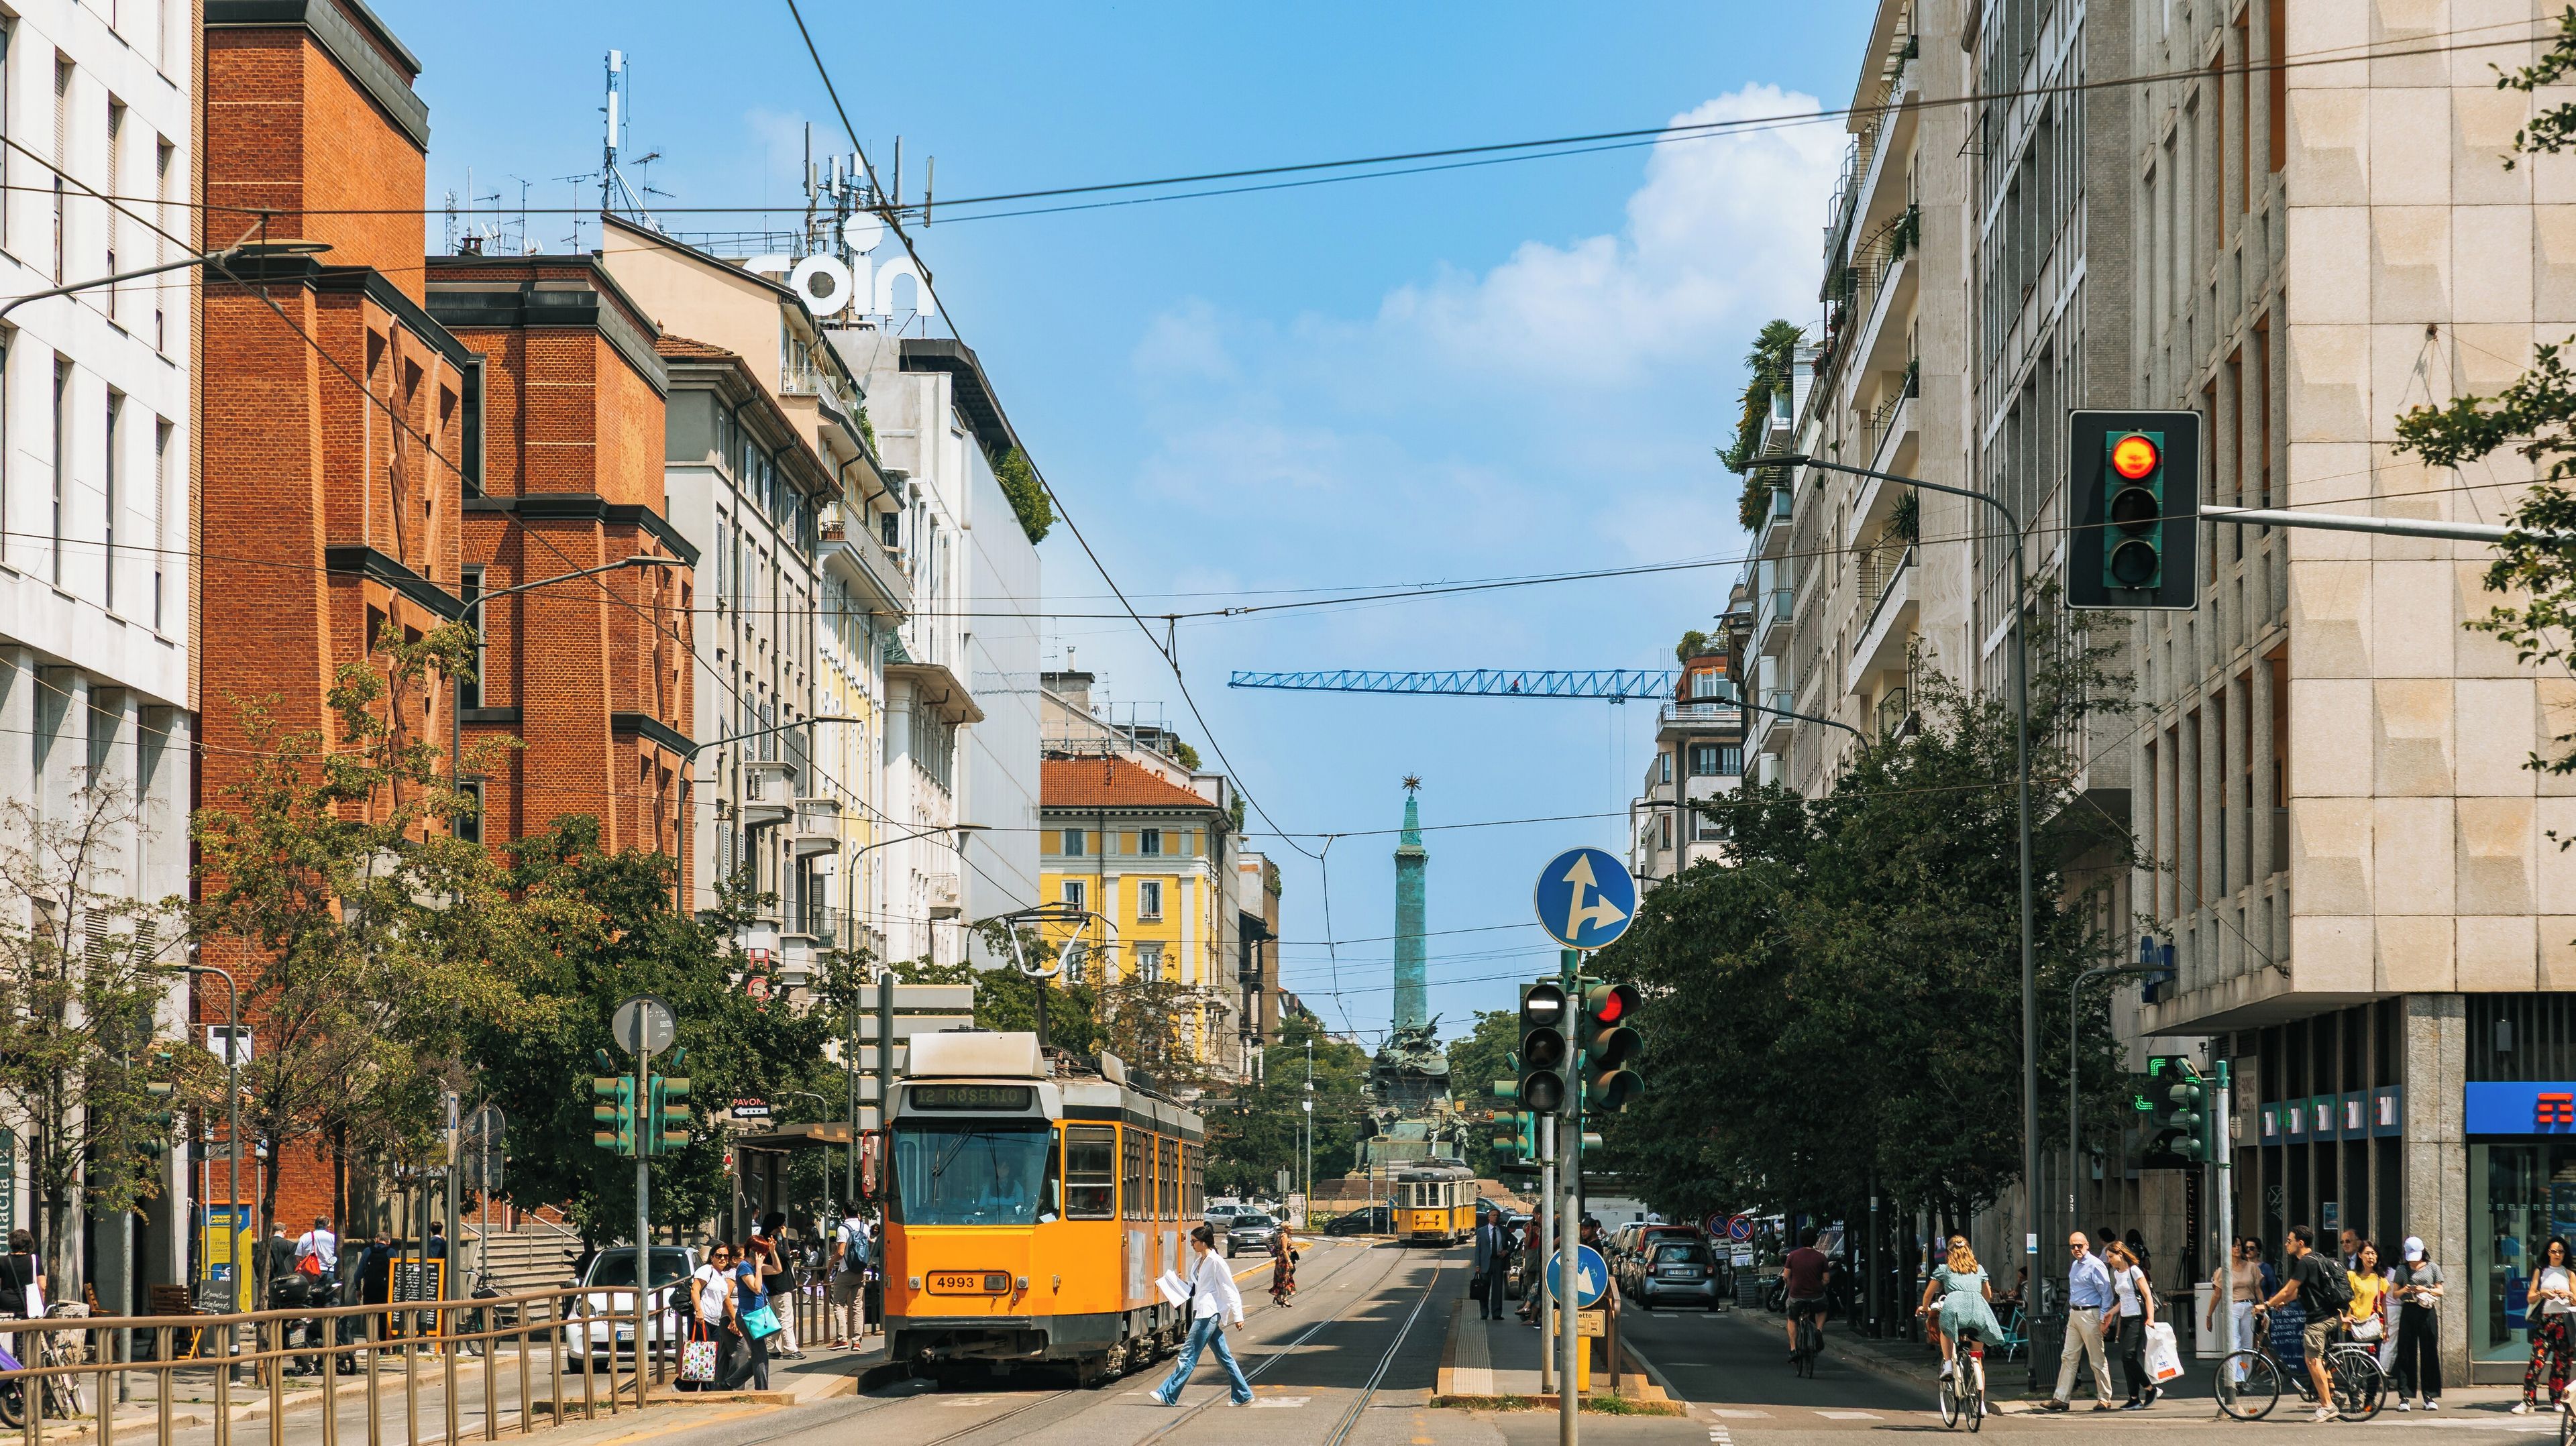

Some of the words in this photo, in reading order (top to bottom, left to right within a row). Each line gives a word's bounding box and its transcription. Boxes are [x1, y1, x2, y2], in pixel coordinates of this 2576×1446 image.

[918, 1089, 934, 1103] 12
[947, 1089, 1018, 1103] ROSERIO
[451, 1100, 455, 1125] P
[937, 1277, 974, 1288] 4993
